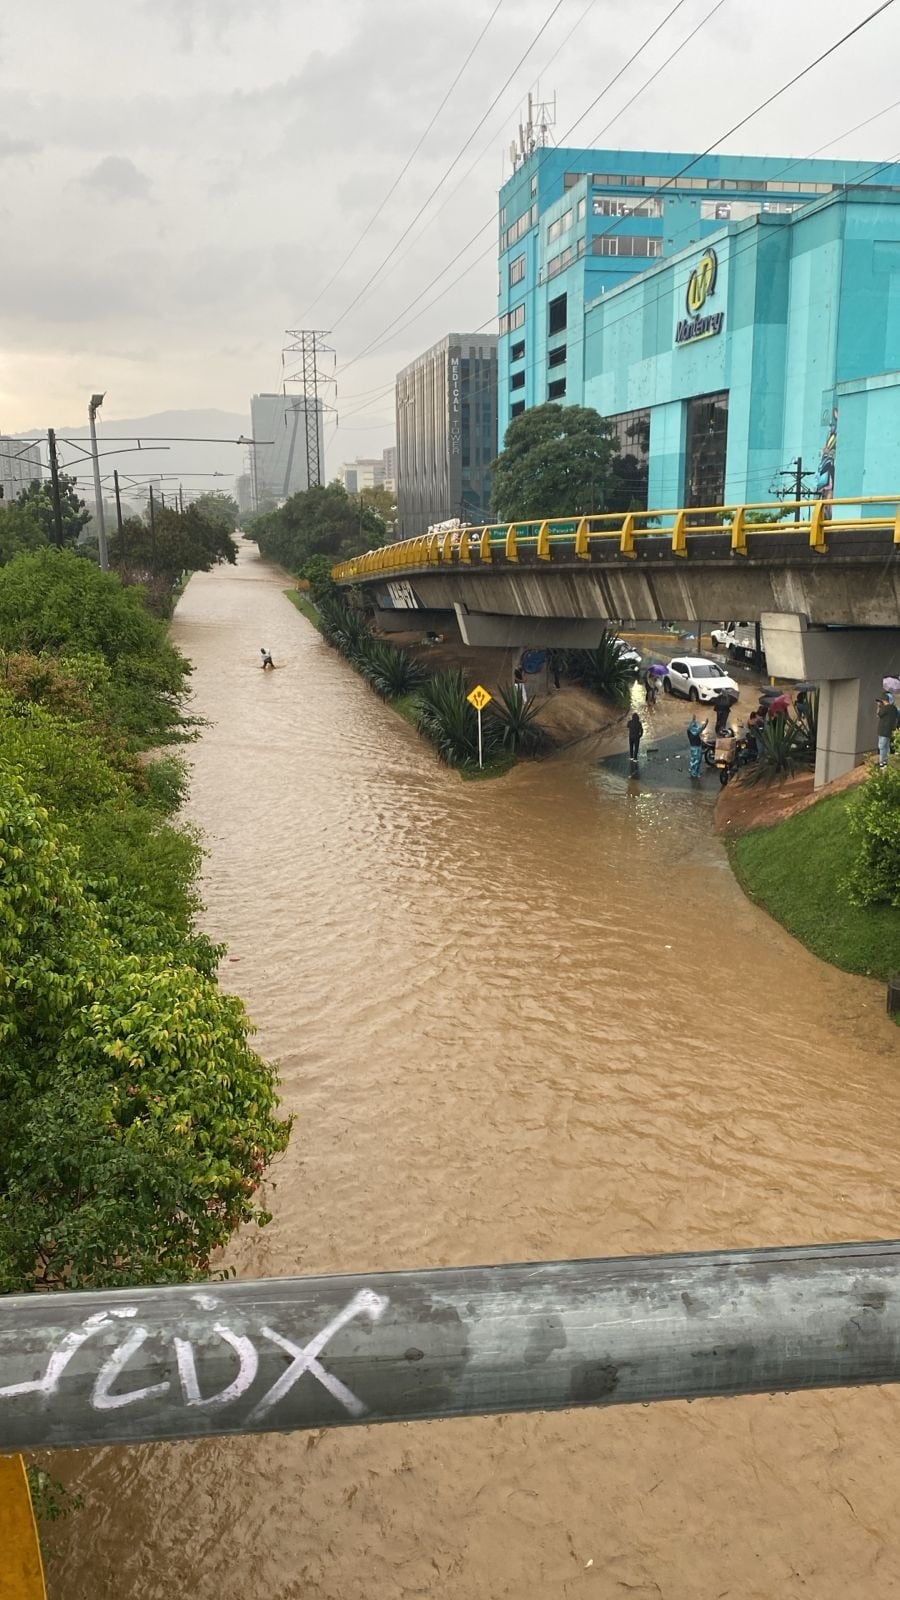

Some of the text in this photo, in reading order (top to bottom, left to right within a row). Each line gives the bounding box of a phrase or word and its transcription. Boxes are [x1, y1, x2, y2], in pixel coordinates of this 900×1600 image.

[675, 312, 724, 343] Monterrey
[451, 358, 461, 455] MEDICAL TOWER
